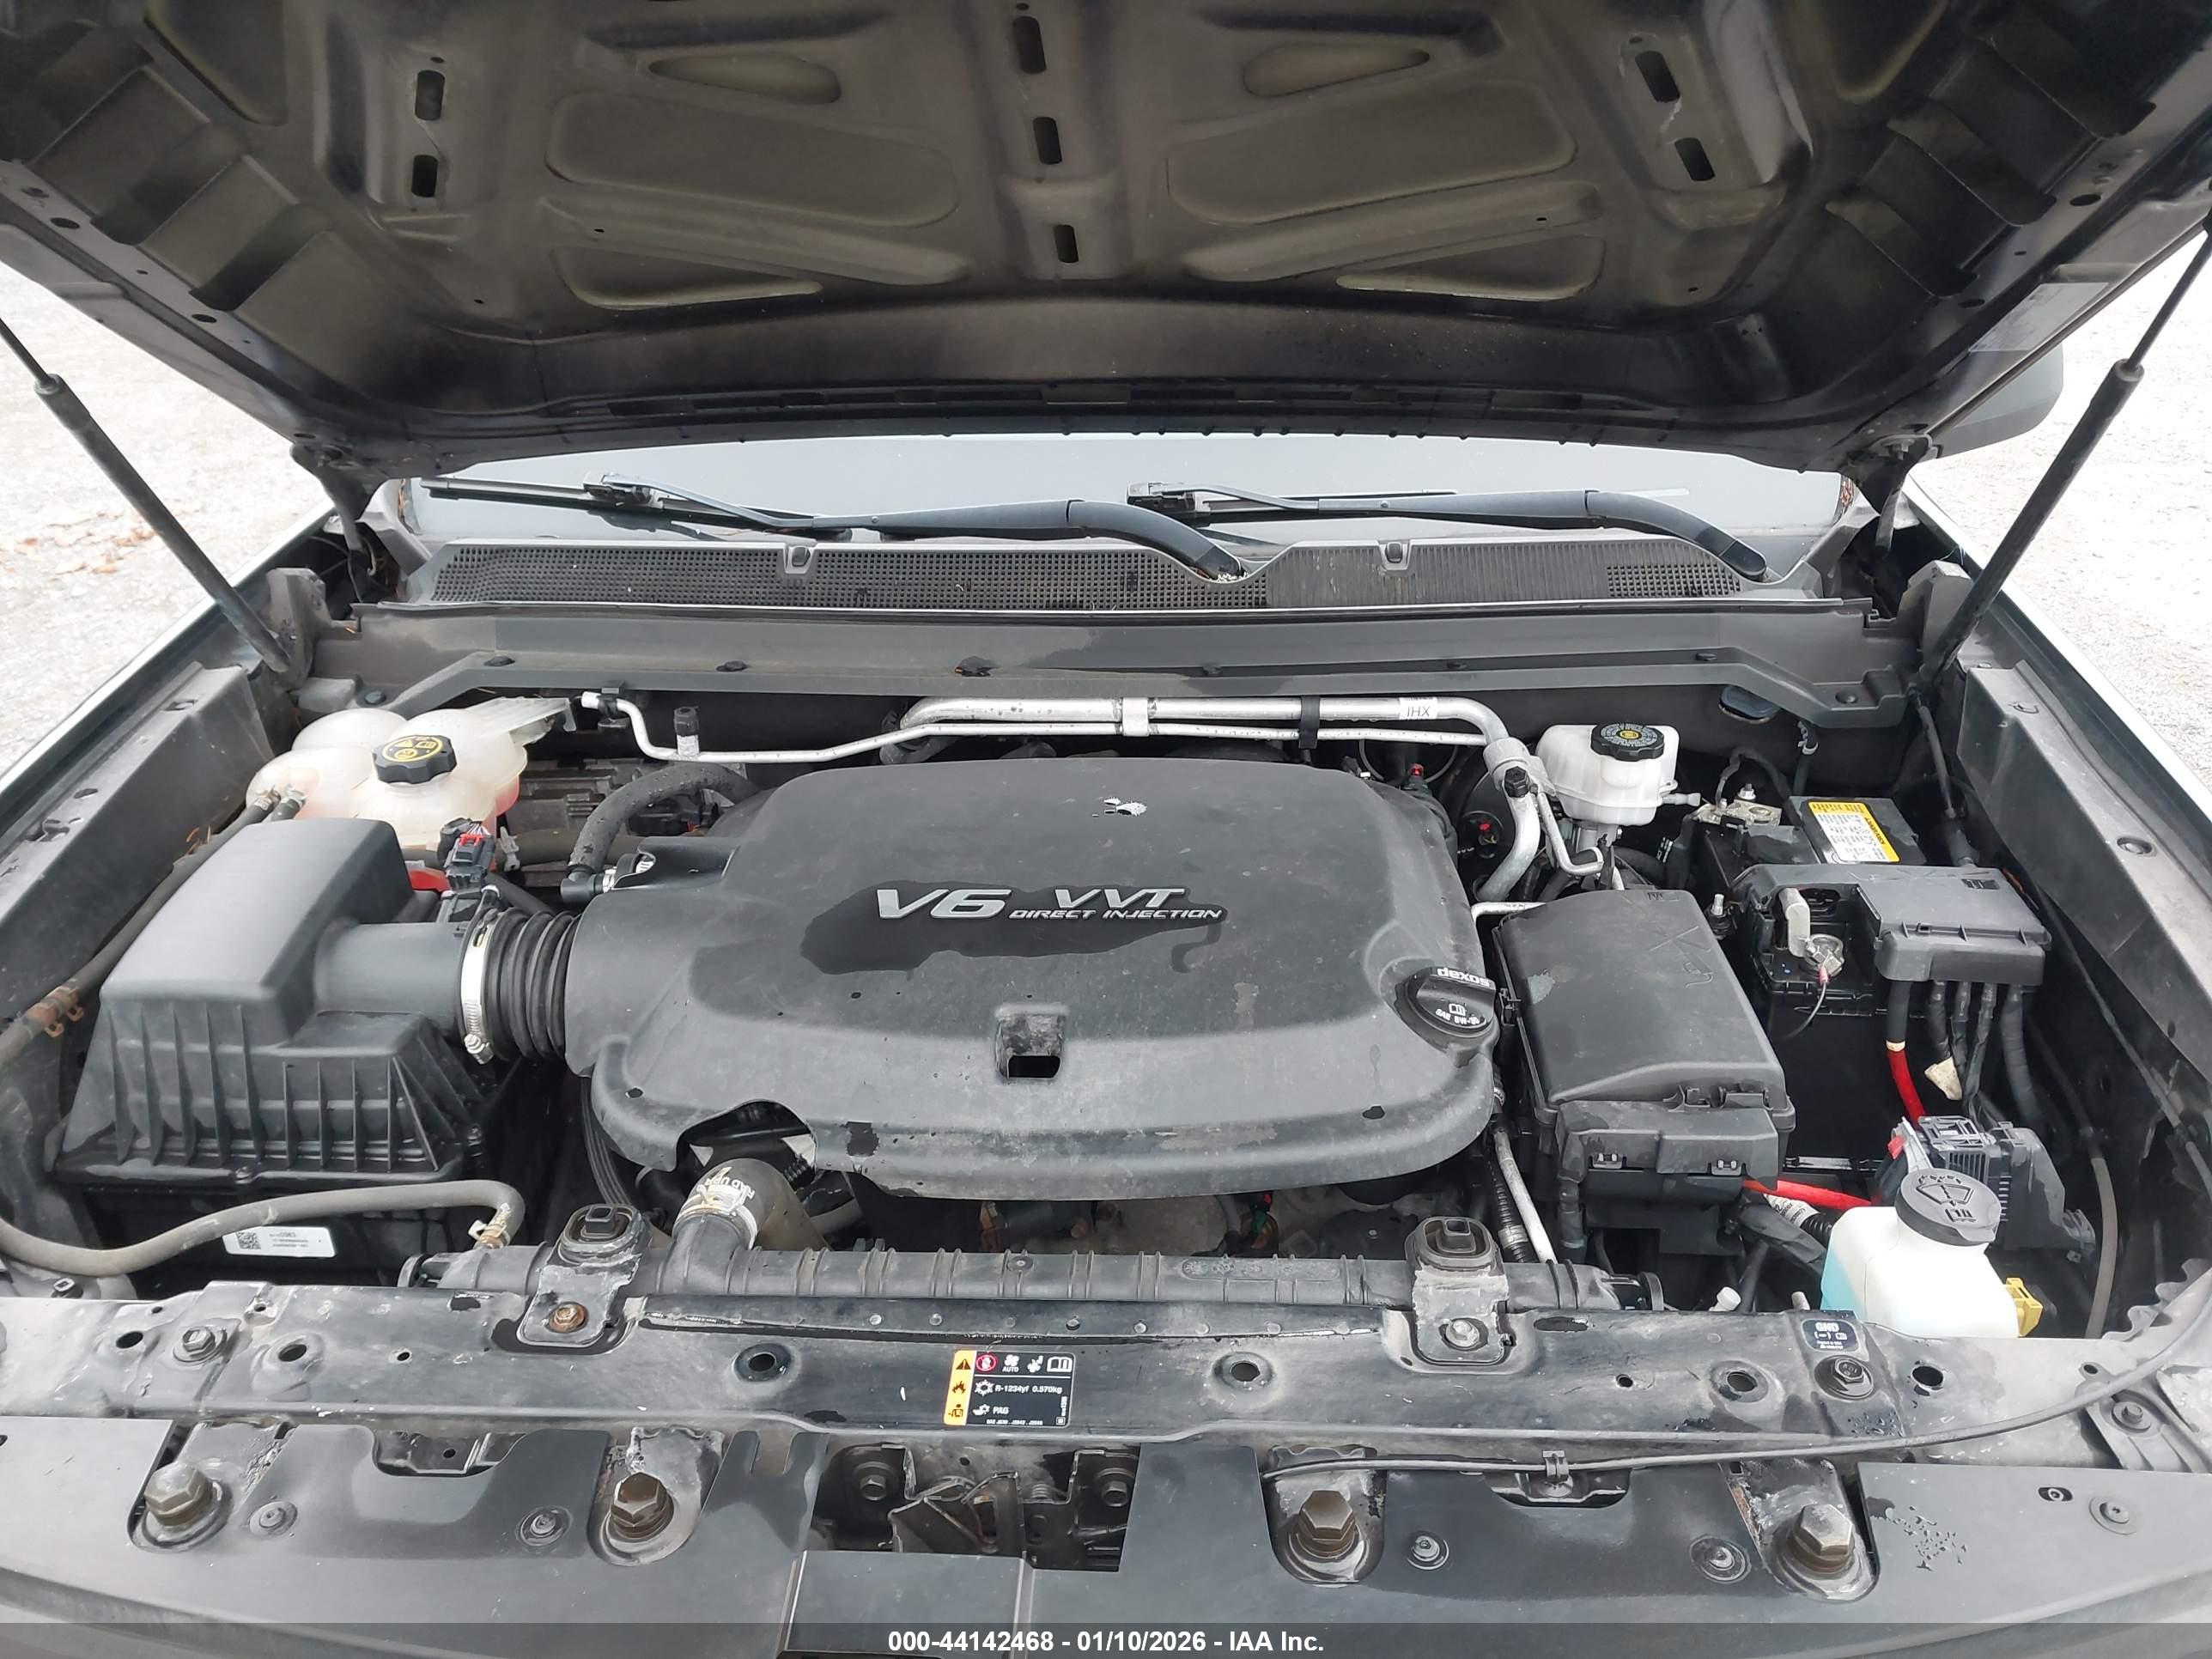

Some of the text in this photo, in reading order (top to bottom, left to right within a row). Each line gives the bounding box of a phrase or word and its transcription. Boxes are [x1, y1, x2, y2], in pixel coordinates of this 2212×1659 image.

[876, 888, 1186, 920] V6 VVT
[1008, 909, 1224, 921] DIRECT INJECTION
[1437, 967, 1490, 987] dexos
[1435, 1008, 1451, 1021] SAE
[1814, 1322, 1839, 1332] GND
[994, 1384, 1063, 1395] R-1234yf 0.570kg
[993, 1406, 1010, 1415] PAG
